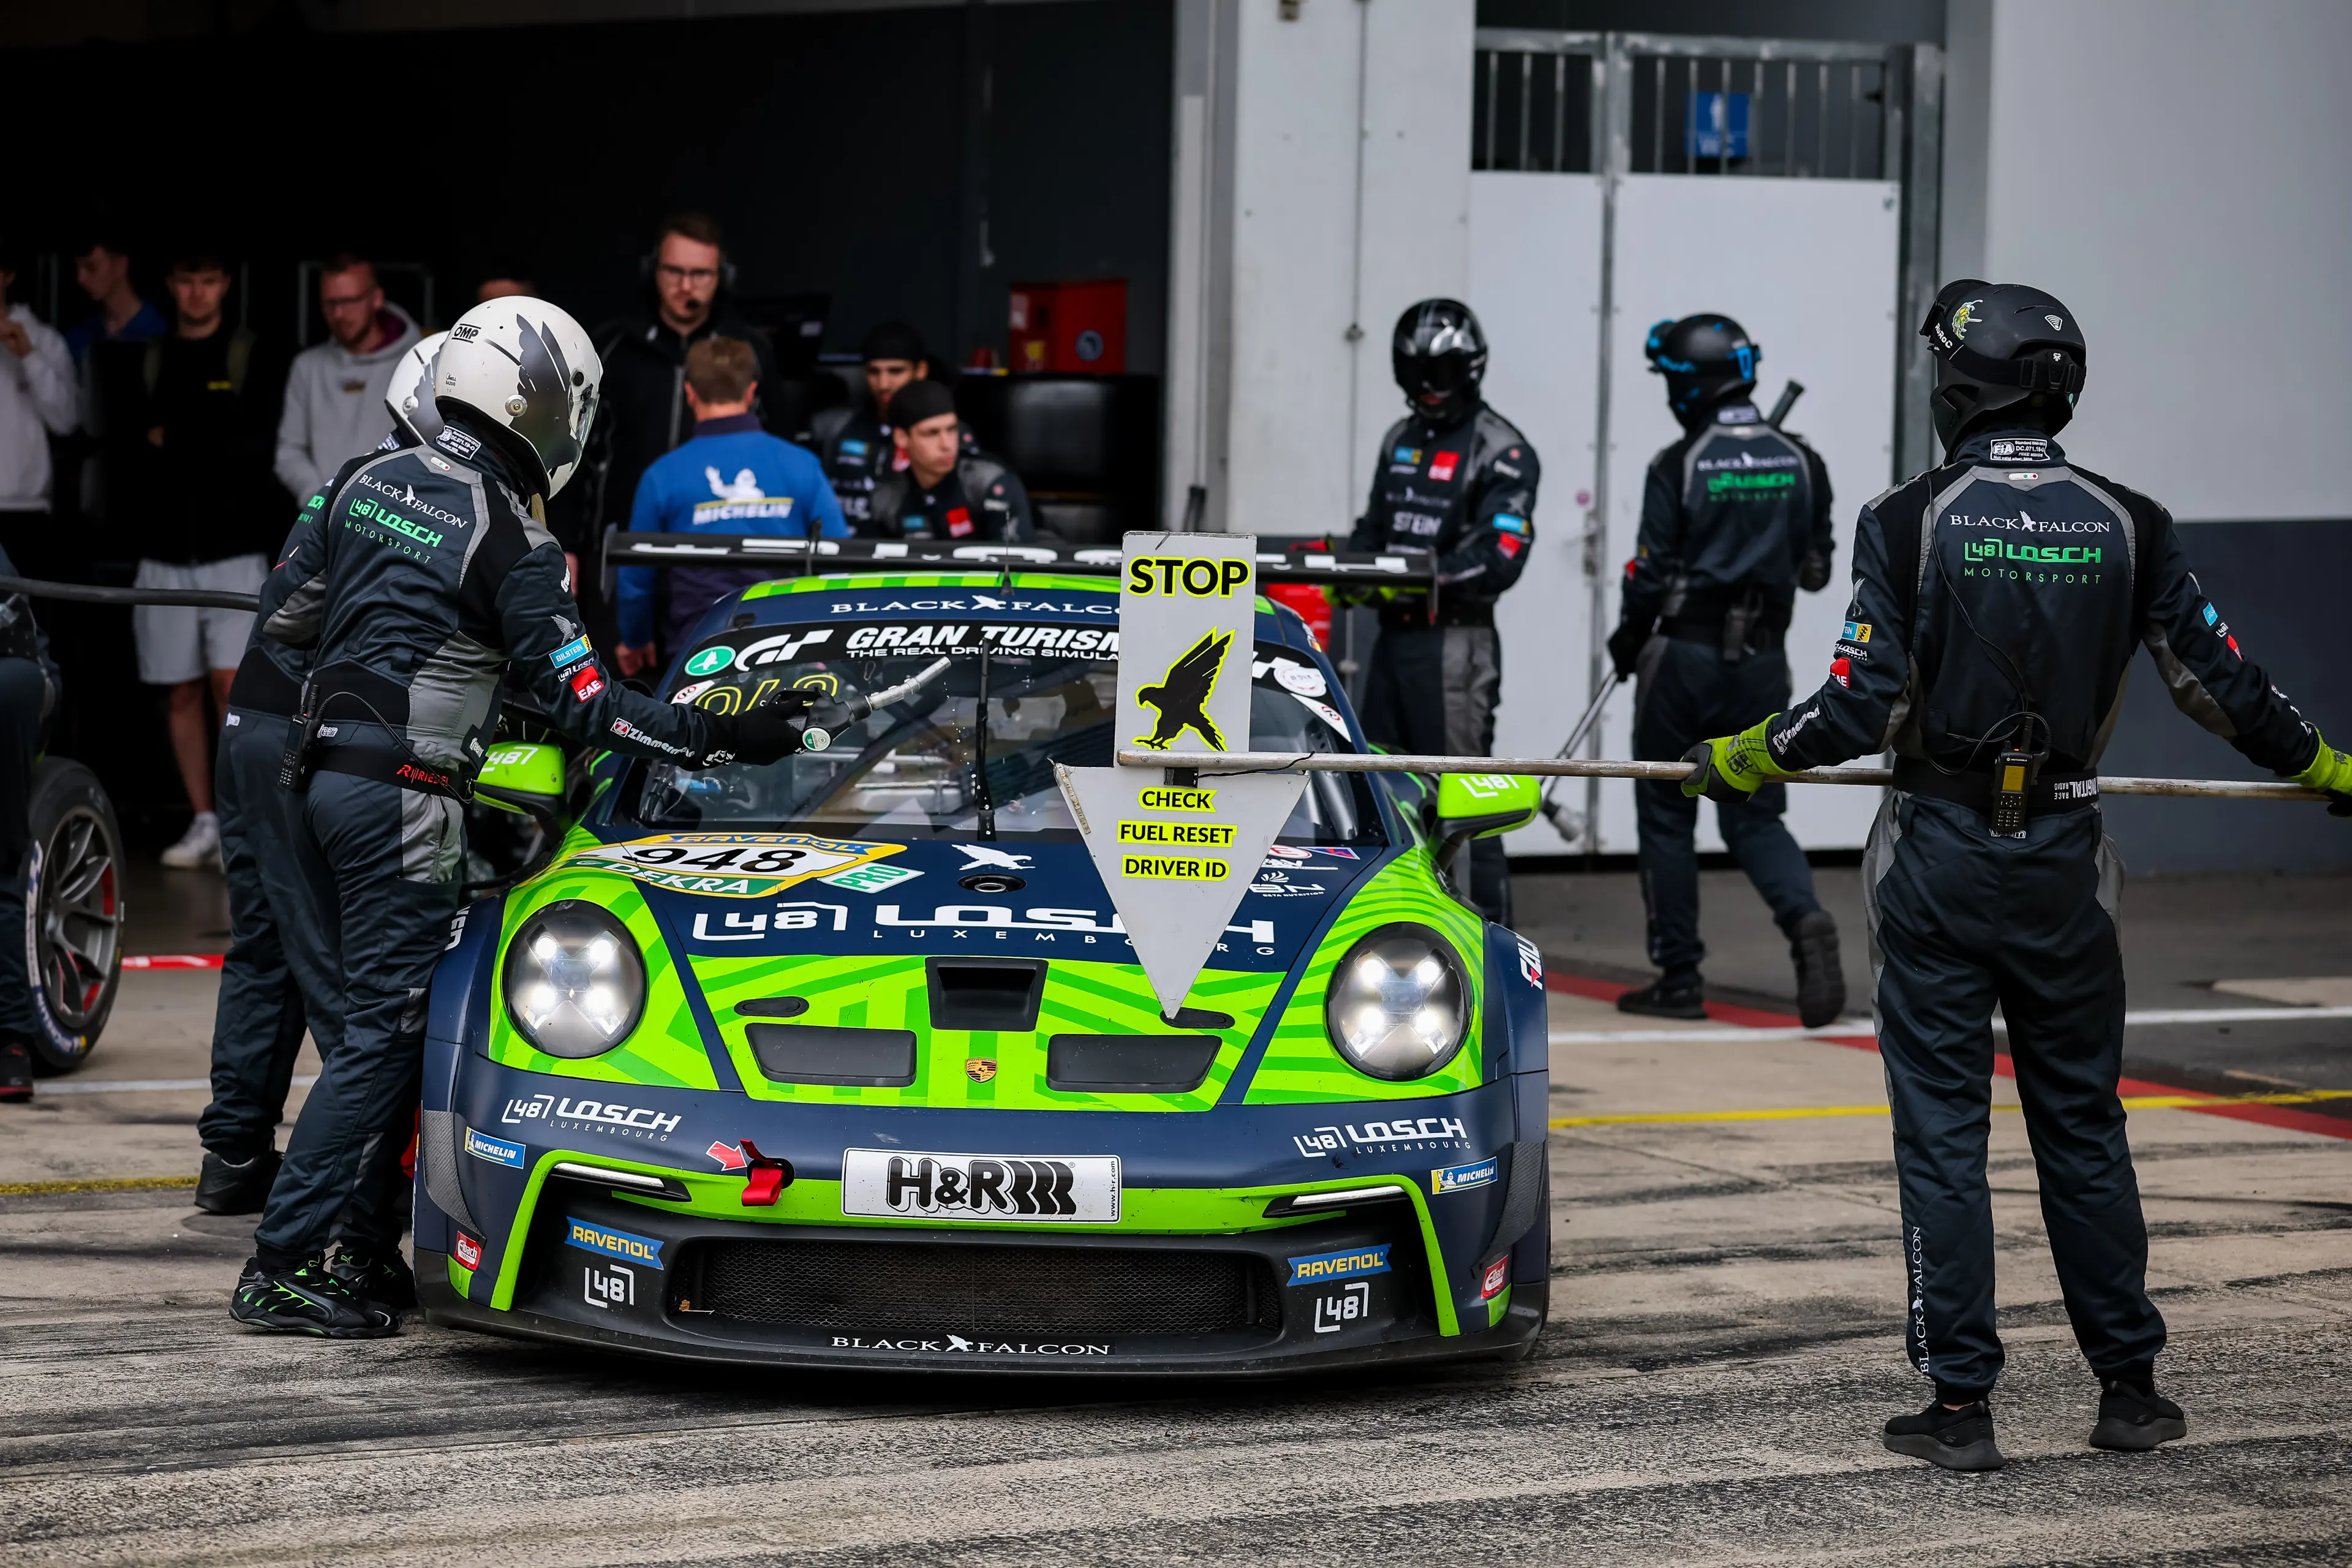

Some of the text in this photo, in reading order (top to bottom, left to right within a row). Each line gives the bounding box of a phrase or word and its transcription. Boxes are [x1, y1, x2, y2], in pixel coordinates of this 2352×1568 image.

[454, 326, 479, 339] OMP
[1936, 323, 1953, 349] RUROC
[358, 475, 468, 529] BLACK FALCON
[375, 508, 443, 548] LOSCH
[1950, 515, 2110, 532] BLACK FALCON
[345, 519, 431, 564] MOTORSPORT
[2007, 544, 2101, 563] LOSCH
[1128, 558, 1250, 595] STOP
[1965, 567, 2100, 584] MOTORSPORT
[831, 600, 1120, 614] BLACK FALC
[846, 625, 969, 649] GRAN
[556, 643, 583, 663] BILSTEIN
[893, 647, 947, 656] REAL
[1041, 649, 1120, 662] SIMULA
[578, 680, 601, 701] EAE
[1142, 791, 1210, 809] CHECK
[1120, 824, 1234, 843] FUEL RESET
[624, 849, 807, 872] 948
[1125, 859, 1227, 878] DRIVER ID
[603, 862, 750, 894] DEKRA
[831, 865, 909, 890] PRO
[875, 905, 1275, 944] LOSH
[873, 930, 1275, 956] LUXEMBRG
[556, 1097, 682, 1132] LOSCH
[549, 1120, 668, 1142] LUXEMBOURG
[1347, 1118, 1467, 1142] LOSCH
[475, 1139, 516, 1158] MICHELIN
[1356, 1141, 1471, 1154] LUXEMBOURG
[1457, 1166, 1494, 1183] MICHELIN
[572, 1227, 653, 1259] RAVENOL
[1297, 1253, 1383, 1278] RAVENOL
[1912, 1226, 1929, 1374] BLACK FALCON
[832, 1336, 1110, 1355] BLACK FALCON
